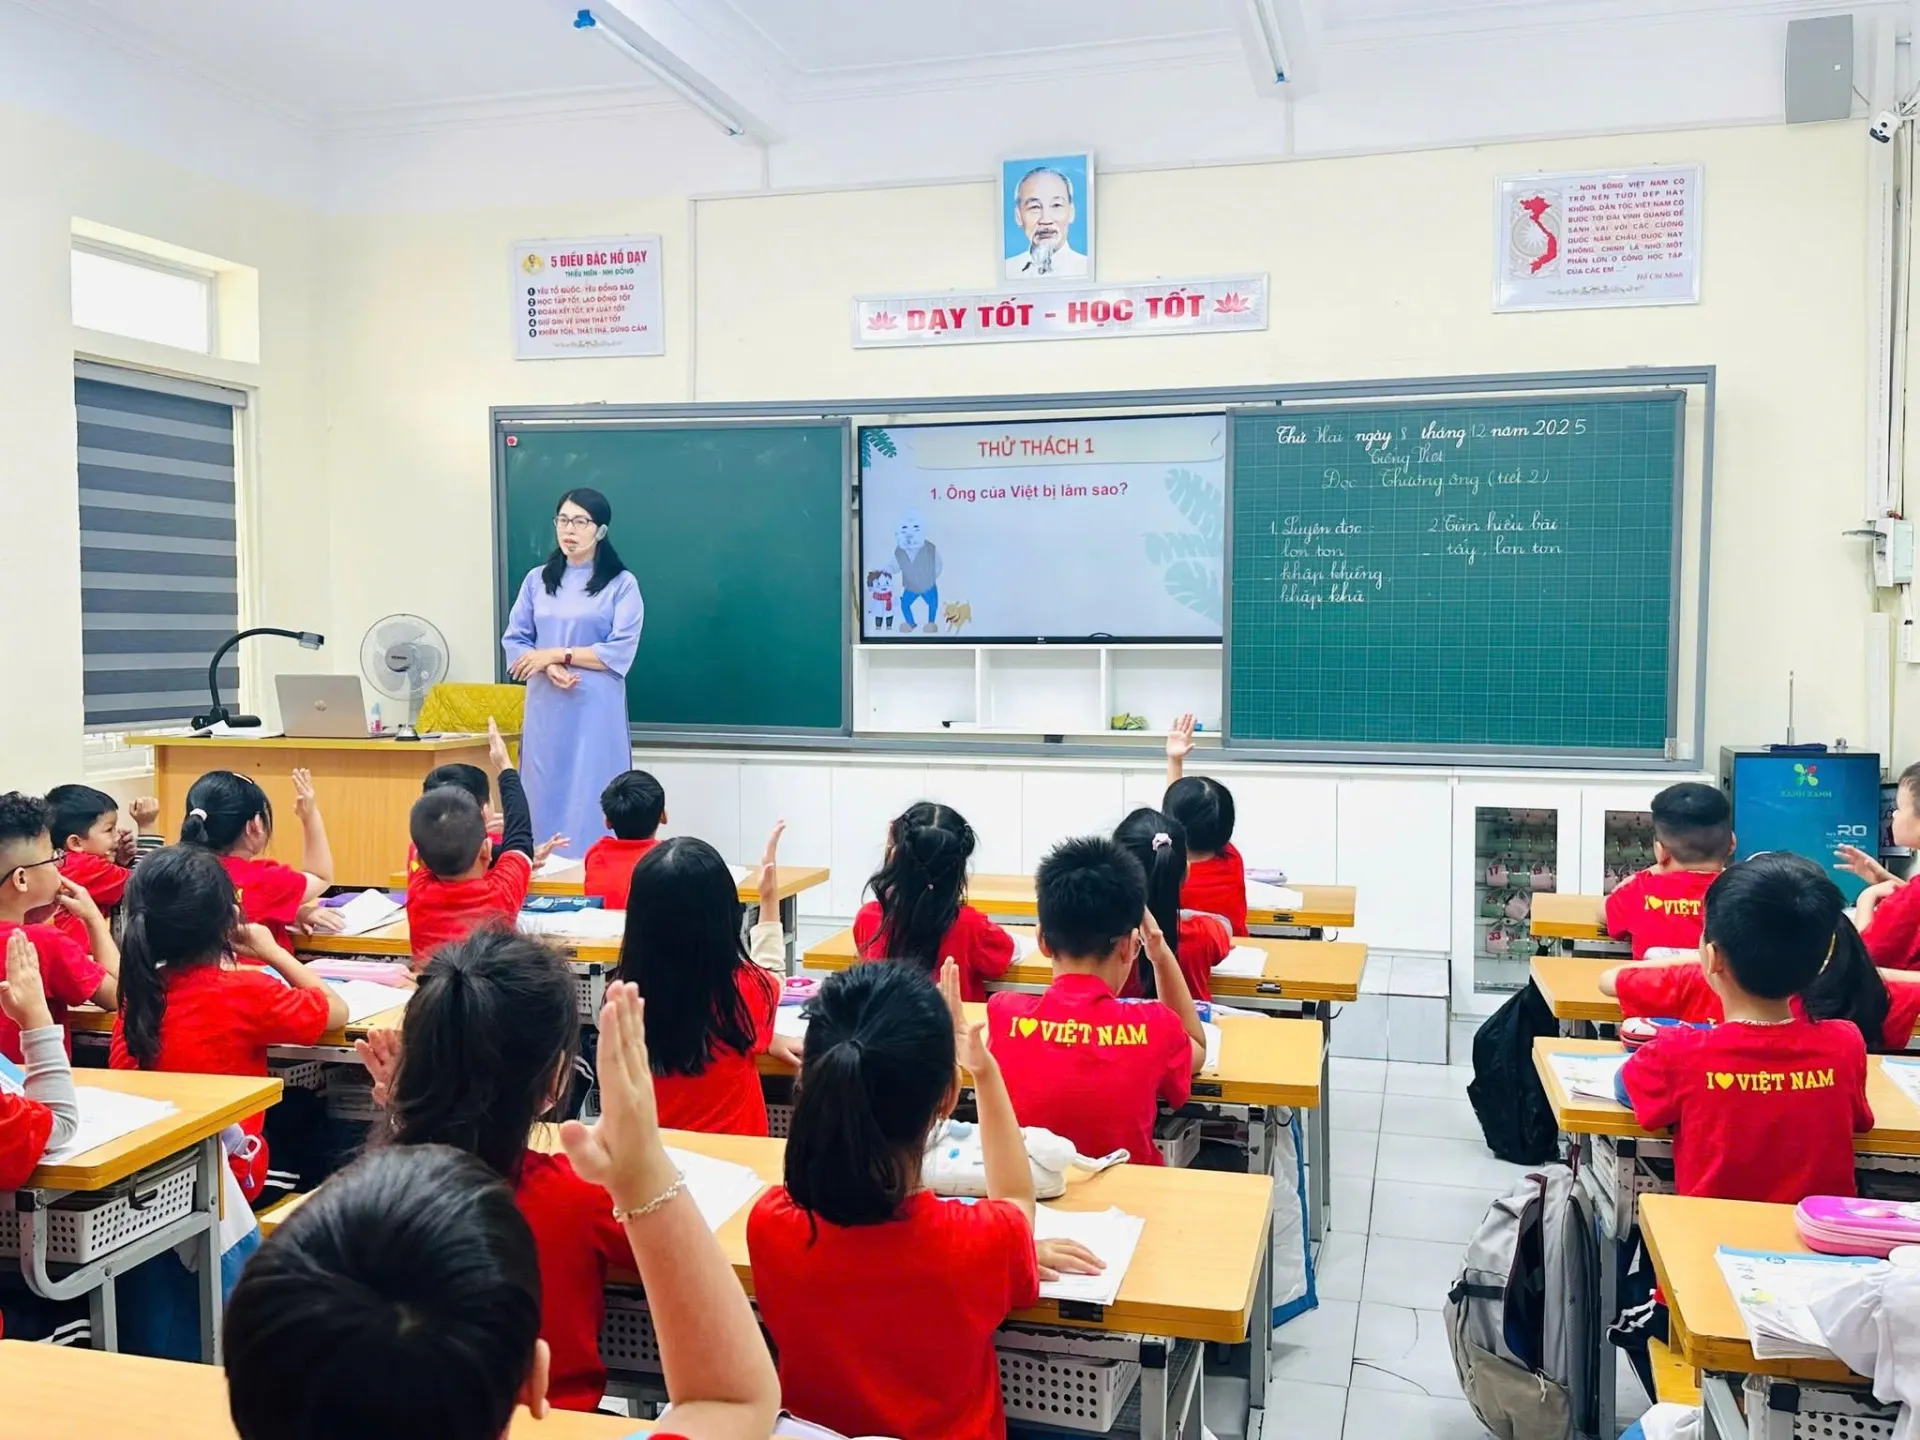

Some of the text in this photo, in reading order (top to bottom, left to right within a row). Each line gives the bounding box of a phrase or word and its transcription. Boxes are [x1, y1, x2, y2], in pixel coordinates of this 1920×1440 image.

[551, 256, 557, 267] 5
[627, 251, 647, 266] DẠY
[907, 307, 967, 335] DẠY
[978, 297, 1033, 327] TỐT
[1068, 300, 1133, 327] HỌC
[1145, 288, 1205, 319] TỐT
[1276, 425, 1307, 444] Thứ
[1313, 425, 1343, 443] Hai
[1355, 429, 1392, 451] ngày
[1400, 427, 1407, 441] 8
[1421, 420, 1466, 448] tháng
[1472, 423, 1486, 438] 12
[1532, 419, 1587, 436] 2025
[978, 436, 1094, 457] THỬ THÁCH 1
[1369, 445, 1410, 473] Tiếng
[931, 482, 1128, 502] 1. Ông của Việt bị làm sao?
[1448, 473, 1479, 495] ông
[1282, 515, 1331, 544] Luyện
[1487, 510, 1524, 532] hiểu
[1281, 538, 1344, 557] lon ton
[1495, 535, 1526, 554] lon
[1532, 542, 1563, 554] ton
[1837, 824, 1867, 836] RO
[1663, 898, 1701, 917] VIỆT
[1488, 931, 1501, 941] 33
[1009, 1016, 1148, 1048] I VIỆT NAM
[1706, 1068, 1835, 1094] I VIỆT NAM
